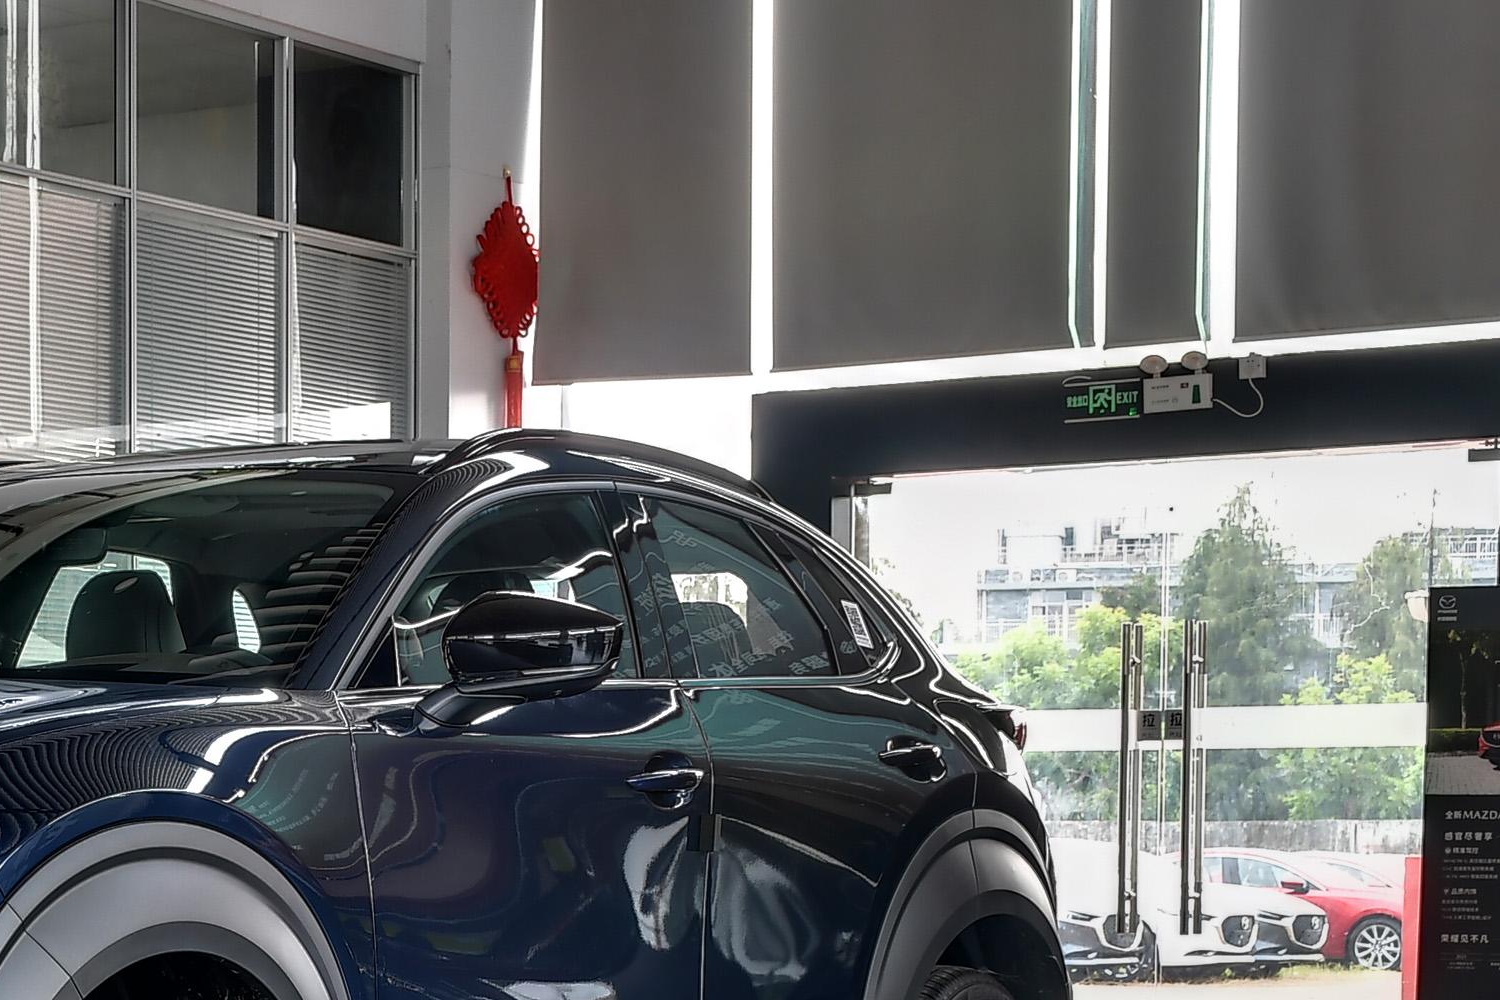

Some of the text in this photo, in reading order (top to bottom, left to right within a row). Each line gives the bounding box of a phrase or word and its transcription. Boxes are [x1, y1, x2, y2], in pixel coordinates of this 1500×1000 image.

[1116, 391, 1138, 404] EXIT
[1143, 713, 1155, 727] 拉
[1445, 810, 1500, 820] 全新MAZD
